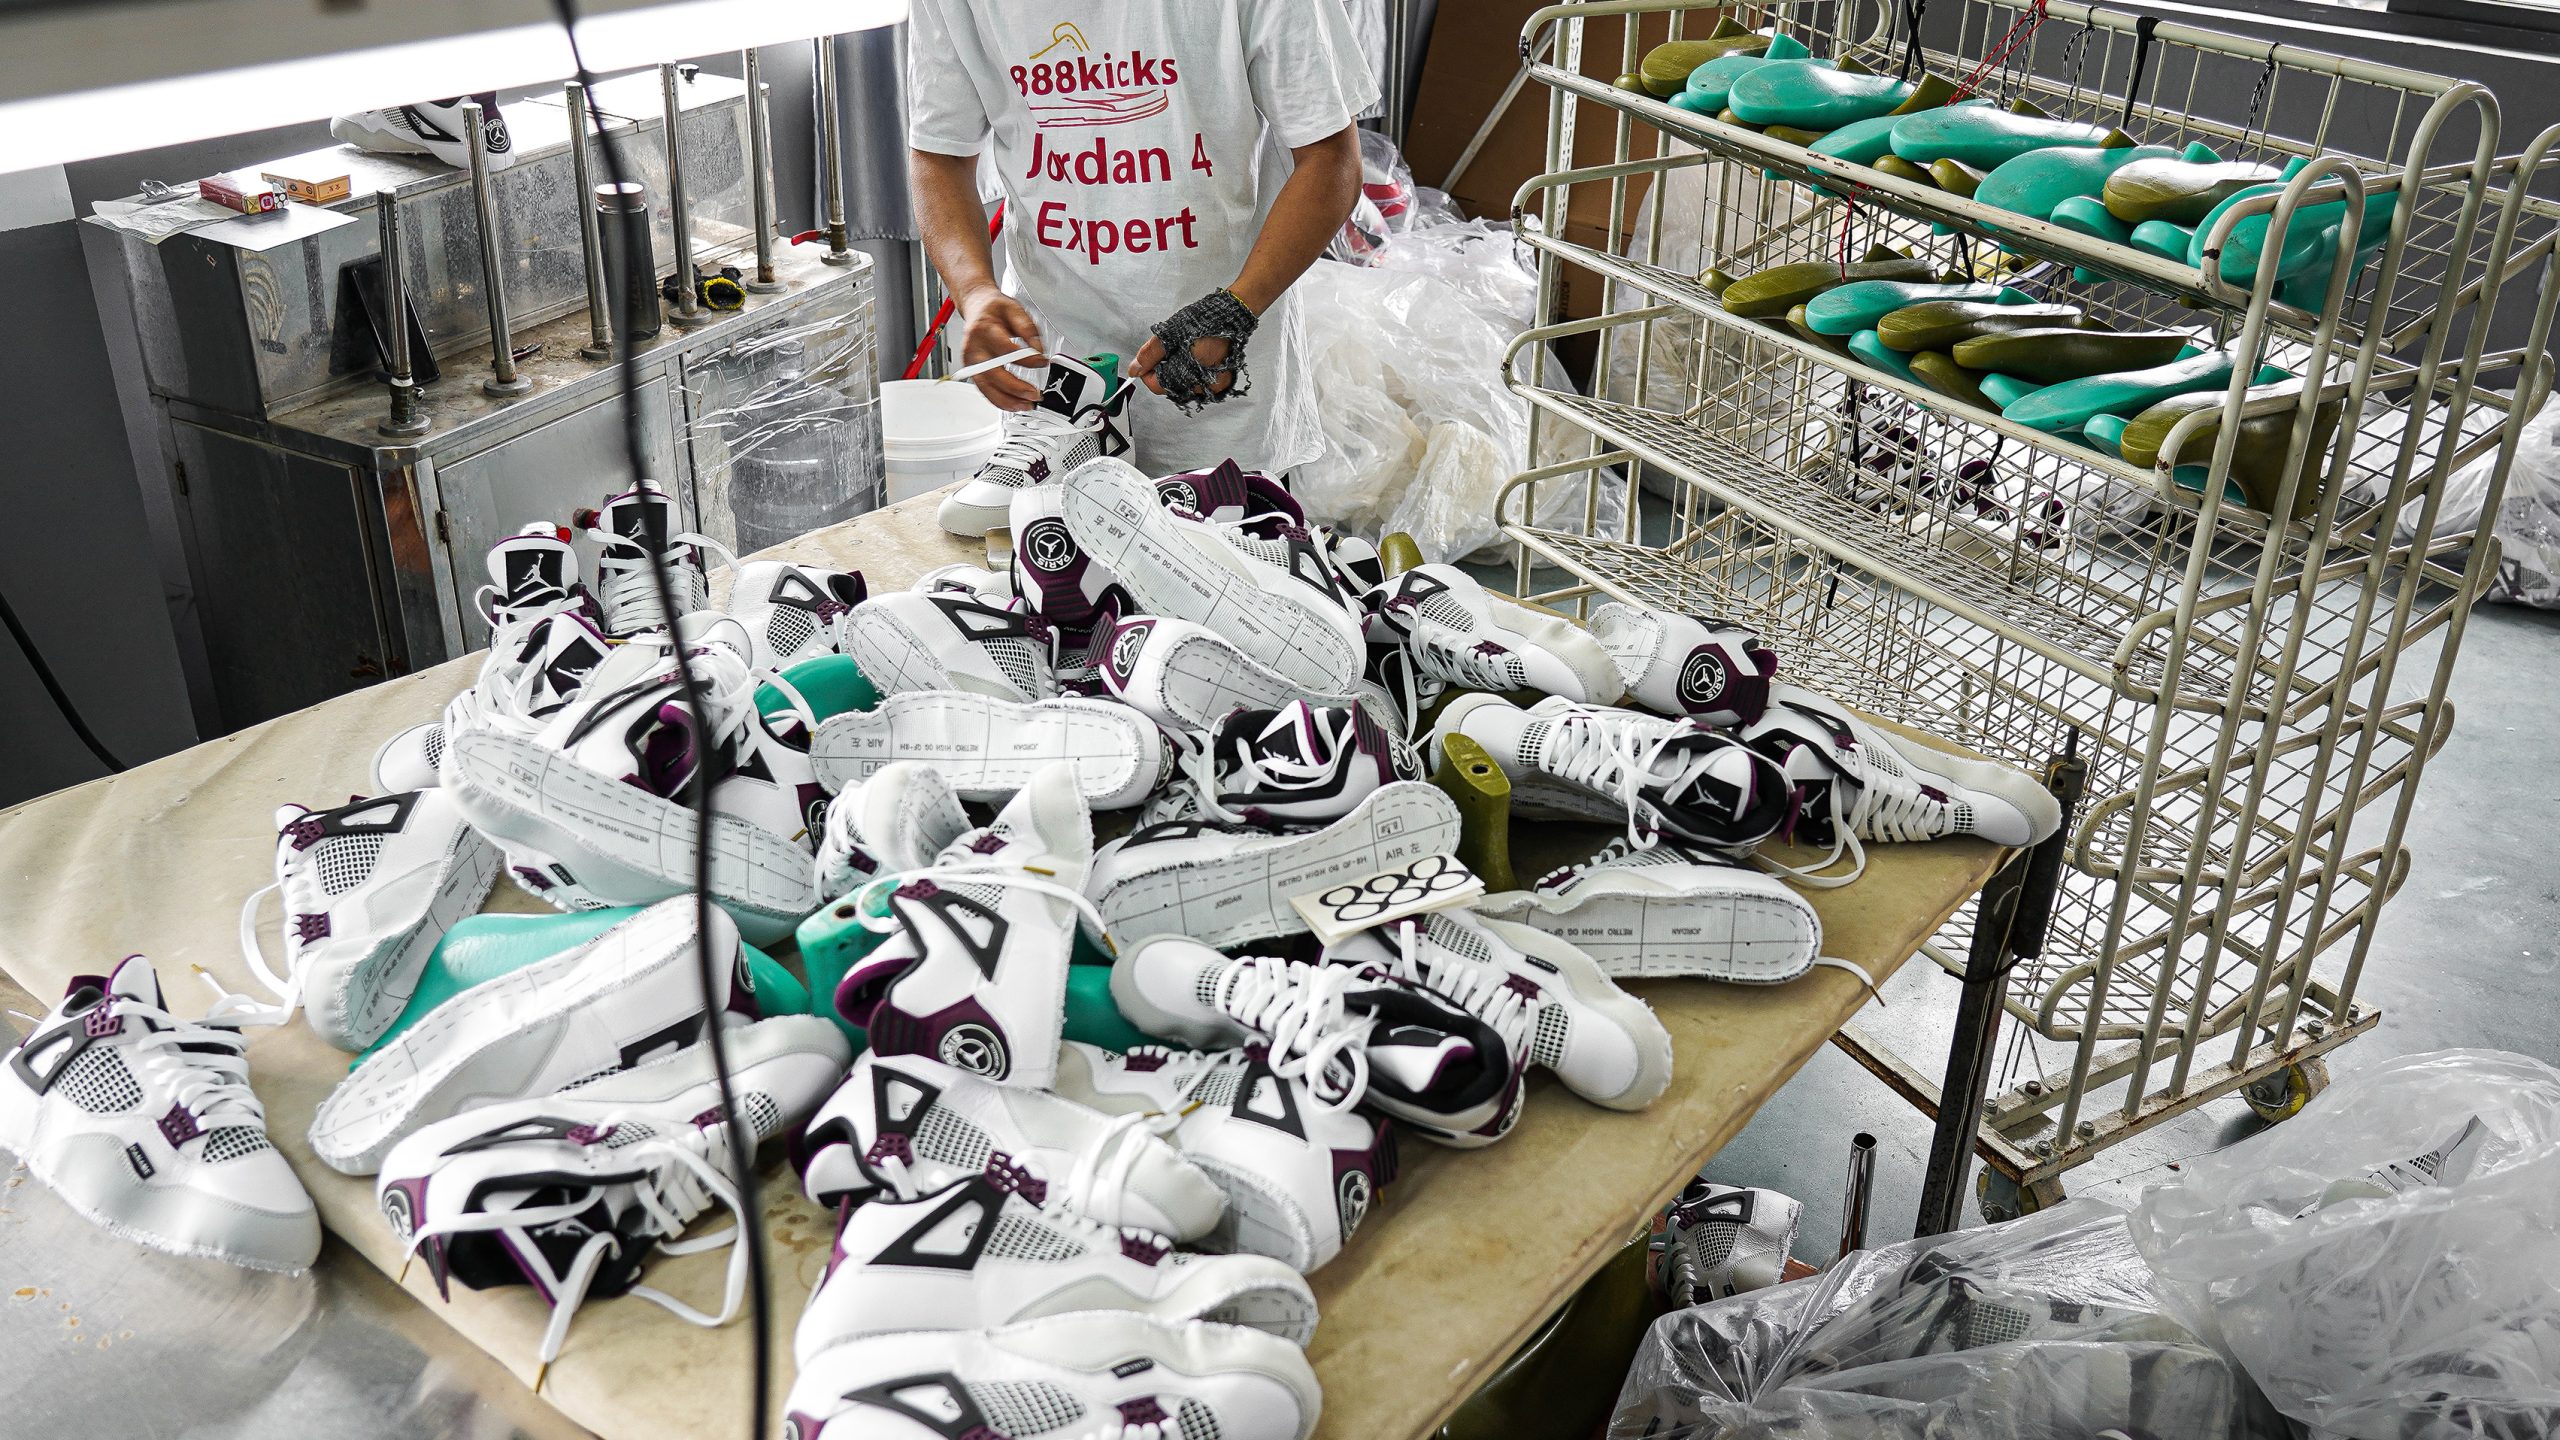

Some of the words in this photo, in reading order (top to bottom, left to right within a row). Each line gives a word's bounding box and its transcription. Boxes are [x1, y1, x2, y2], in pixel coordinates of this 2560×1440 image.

[1010, 50, 1178, 97] 888kicks
[1026, 132, 1172, 185] Jordan
[1191, 132, 1213, 178] 4
[1037, 201, 1198, 265] Expert
[1107, 524, 1126, 539] AIR
[1036, 554, 1071, 569] PARIS
[1172, 567, 1191, 583] HIGH
[1238, 616, 1261, 635] JORDAN
[1706, 667, 1723, 699] PARIS
[867, 738, 885, 748] AIR
[1385, 847, 1405, 861] AIR
[1278, 875, 1302, 888] RETRO
[1305, 869, 1326, 880] HIGH
[1215, 893, 1242, 909] JORDAN
[1568, 928, 1579, 936] OG
[1582, 928, 1604, 936] HIGH
[1607, 928, 1633, 936] RETRO
[1672, 928, 1702, 936] JORDAN
